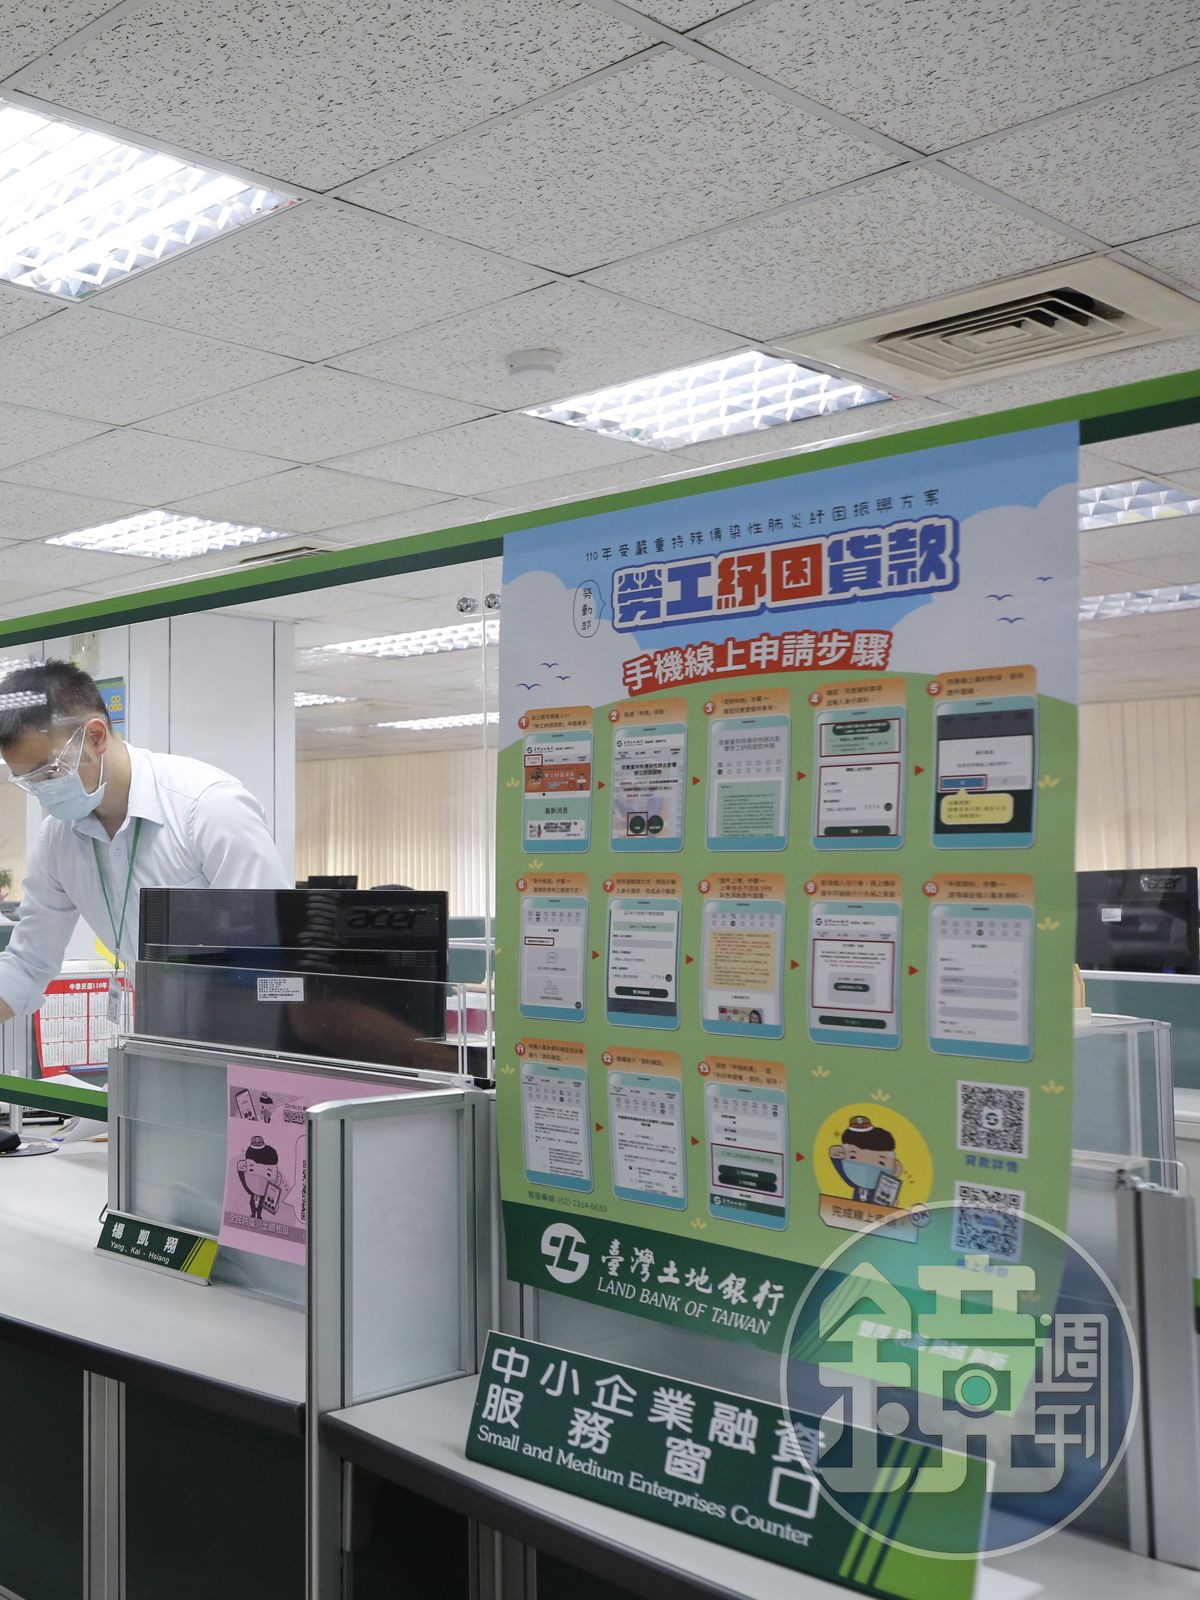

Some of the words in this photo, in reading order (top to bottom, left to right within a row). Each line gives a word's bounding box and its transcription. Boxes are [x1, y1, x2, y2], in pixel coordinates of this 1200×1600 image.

[616, 523, 948, 624] 勞工紓困貸款
[581, 587, 593, 632] 勞動部
[623, 632, 891, 692] 手機線上申請步驟
[347, 908, 427, 931] acer
[111, 1222, 179, 1254] 楊凱翔
[130, 1246, 142, 1256] Kai
[148, 1251, 170, 1265] Hsiang
[597, 1276, 636, 1300] LAND
[639, 1287, 682, 1313] BANK
[684, 1300, 707, 1319] OF
[712, 1306, 772, 1336] TAIWAN
[601, 1238, 785, 1317] 臺灣土地銀行
[490, 1346, 827, 1473] 中小企業融資
[482, 1382, 821, 1520] 服務窗口
[477, 1425, 520, 1452] Small
[522, 1441, 554, 1463] and
[556, 1448, 625, 1485] Medium
[628, 1470, 728, 1519] Enterprises
[730, 1504, 814, 1547] Counter
